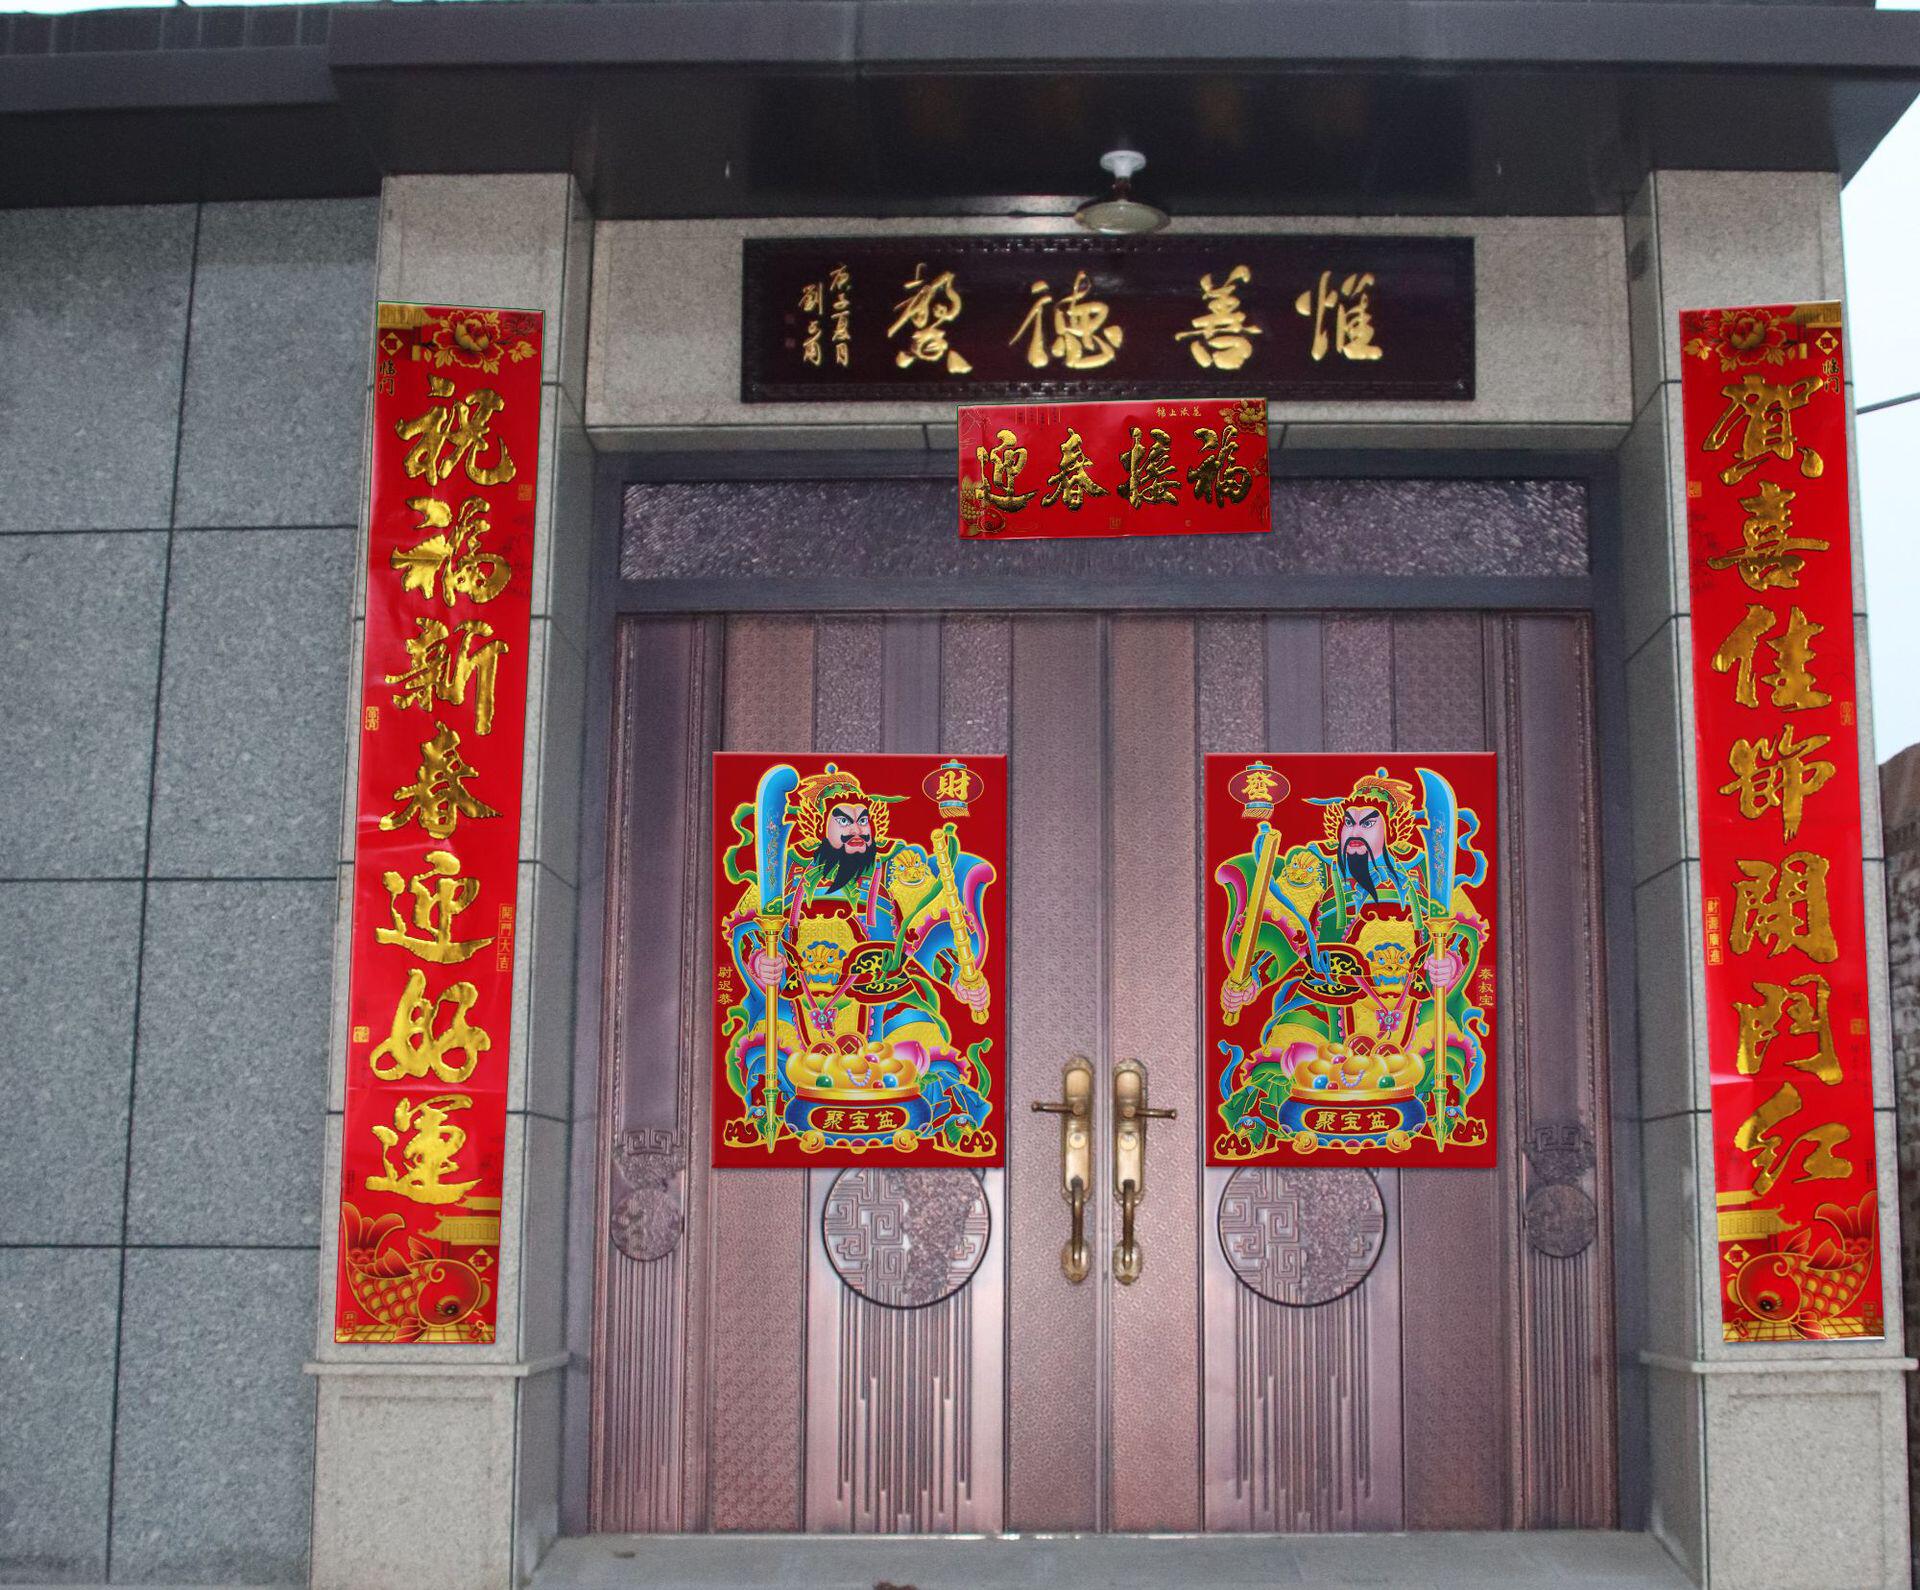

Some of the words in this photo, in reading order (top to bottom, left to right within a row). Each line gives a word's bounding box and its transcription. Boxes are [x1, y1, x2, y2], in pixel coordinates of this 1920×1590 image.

[976, 424, 1252, 513] 迎春接福
[822, 1110, 898, 1131] 聚宝盆
[1313, 1111, 1390, 1132] 聚宝盆
